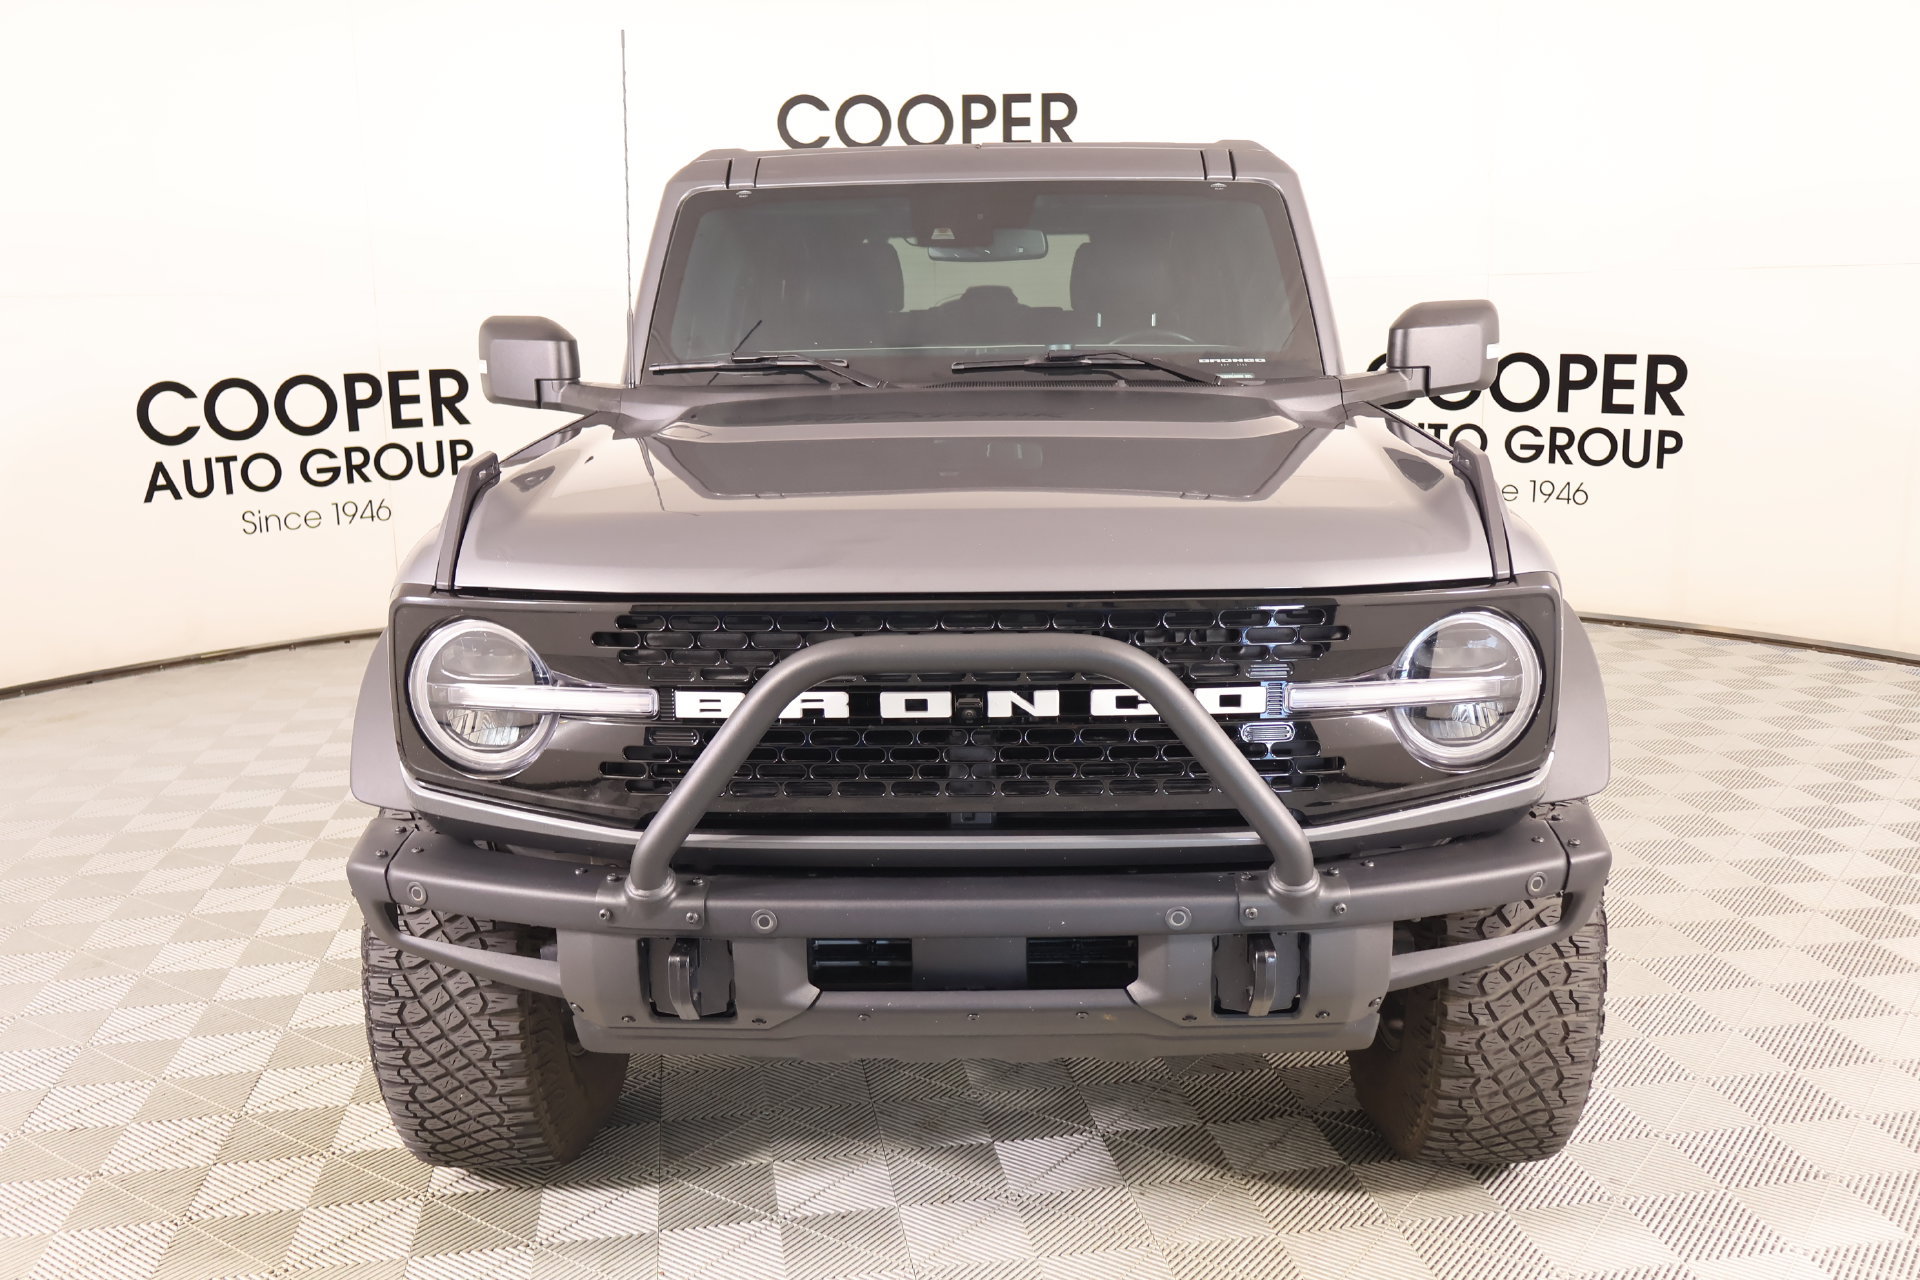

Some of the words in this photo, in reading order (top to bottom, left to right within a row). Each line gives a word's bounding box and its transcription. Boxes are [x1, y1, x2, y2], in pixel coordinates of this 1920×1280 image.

[777, 93, 1078, 149] COOPER
[136, 368, 471, 446] COOPER
[1366, 352, 1689, 416] OPER
[143, 452, 282, 503] AUTO
[300, 438, 474, 488] GROUP
[1504, 424, 1684, 470] GROUP
[241, 507, 322, 535] Since
[331, 498, 392, 526] 1946
[1528, 479, 1589, 505] 1946
[674, 687, 1267, 719] BRONCO
